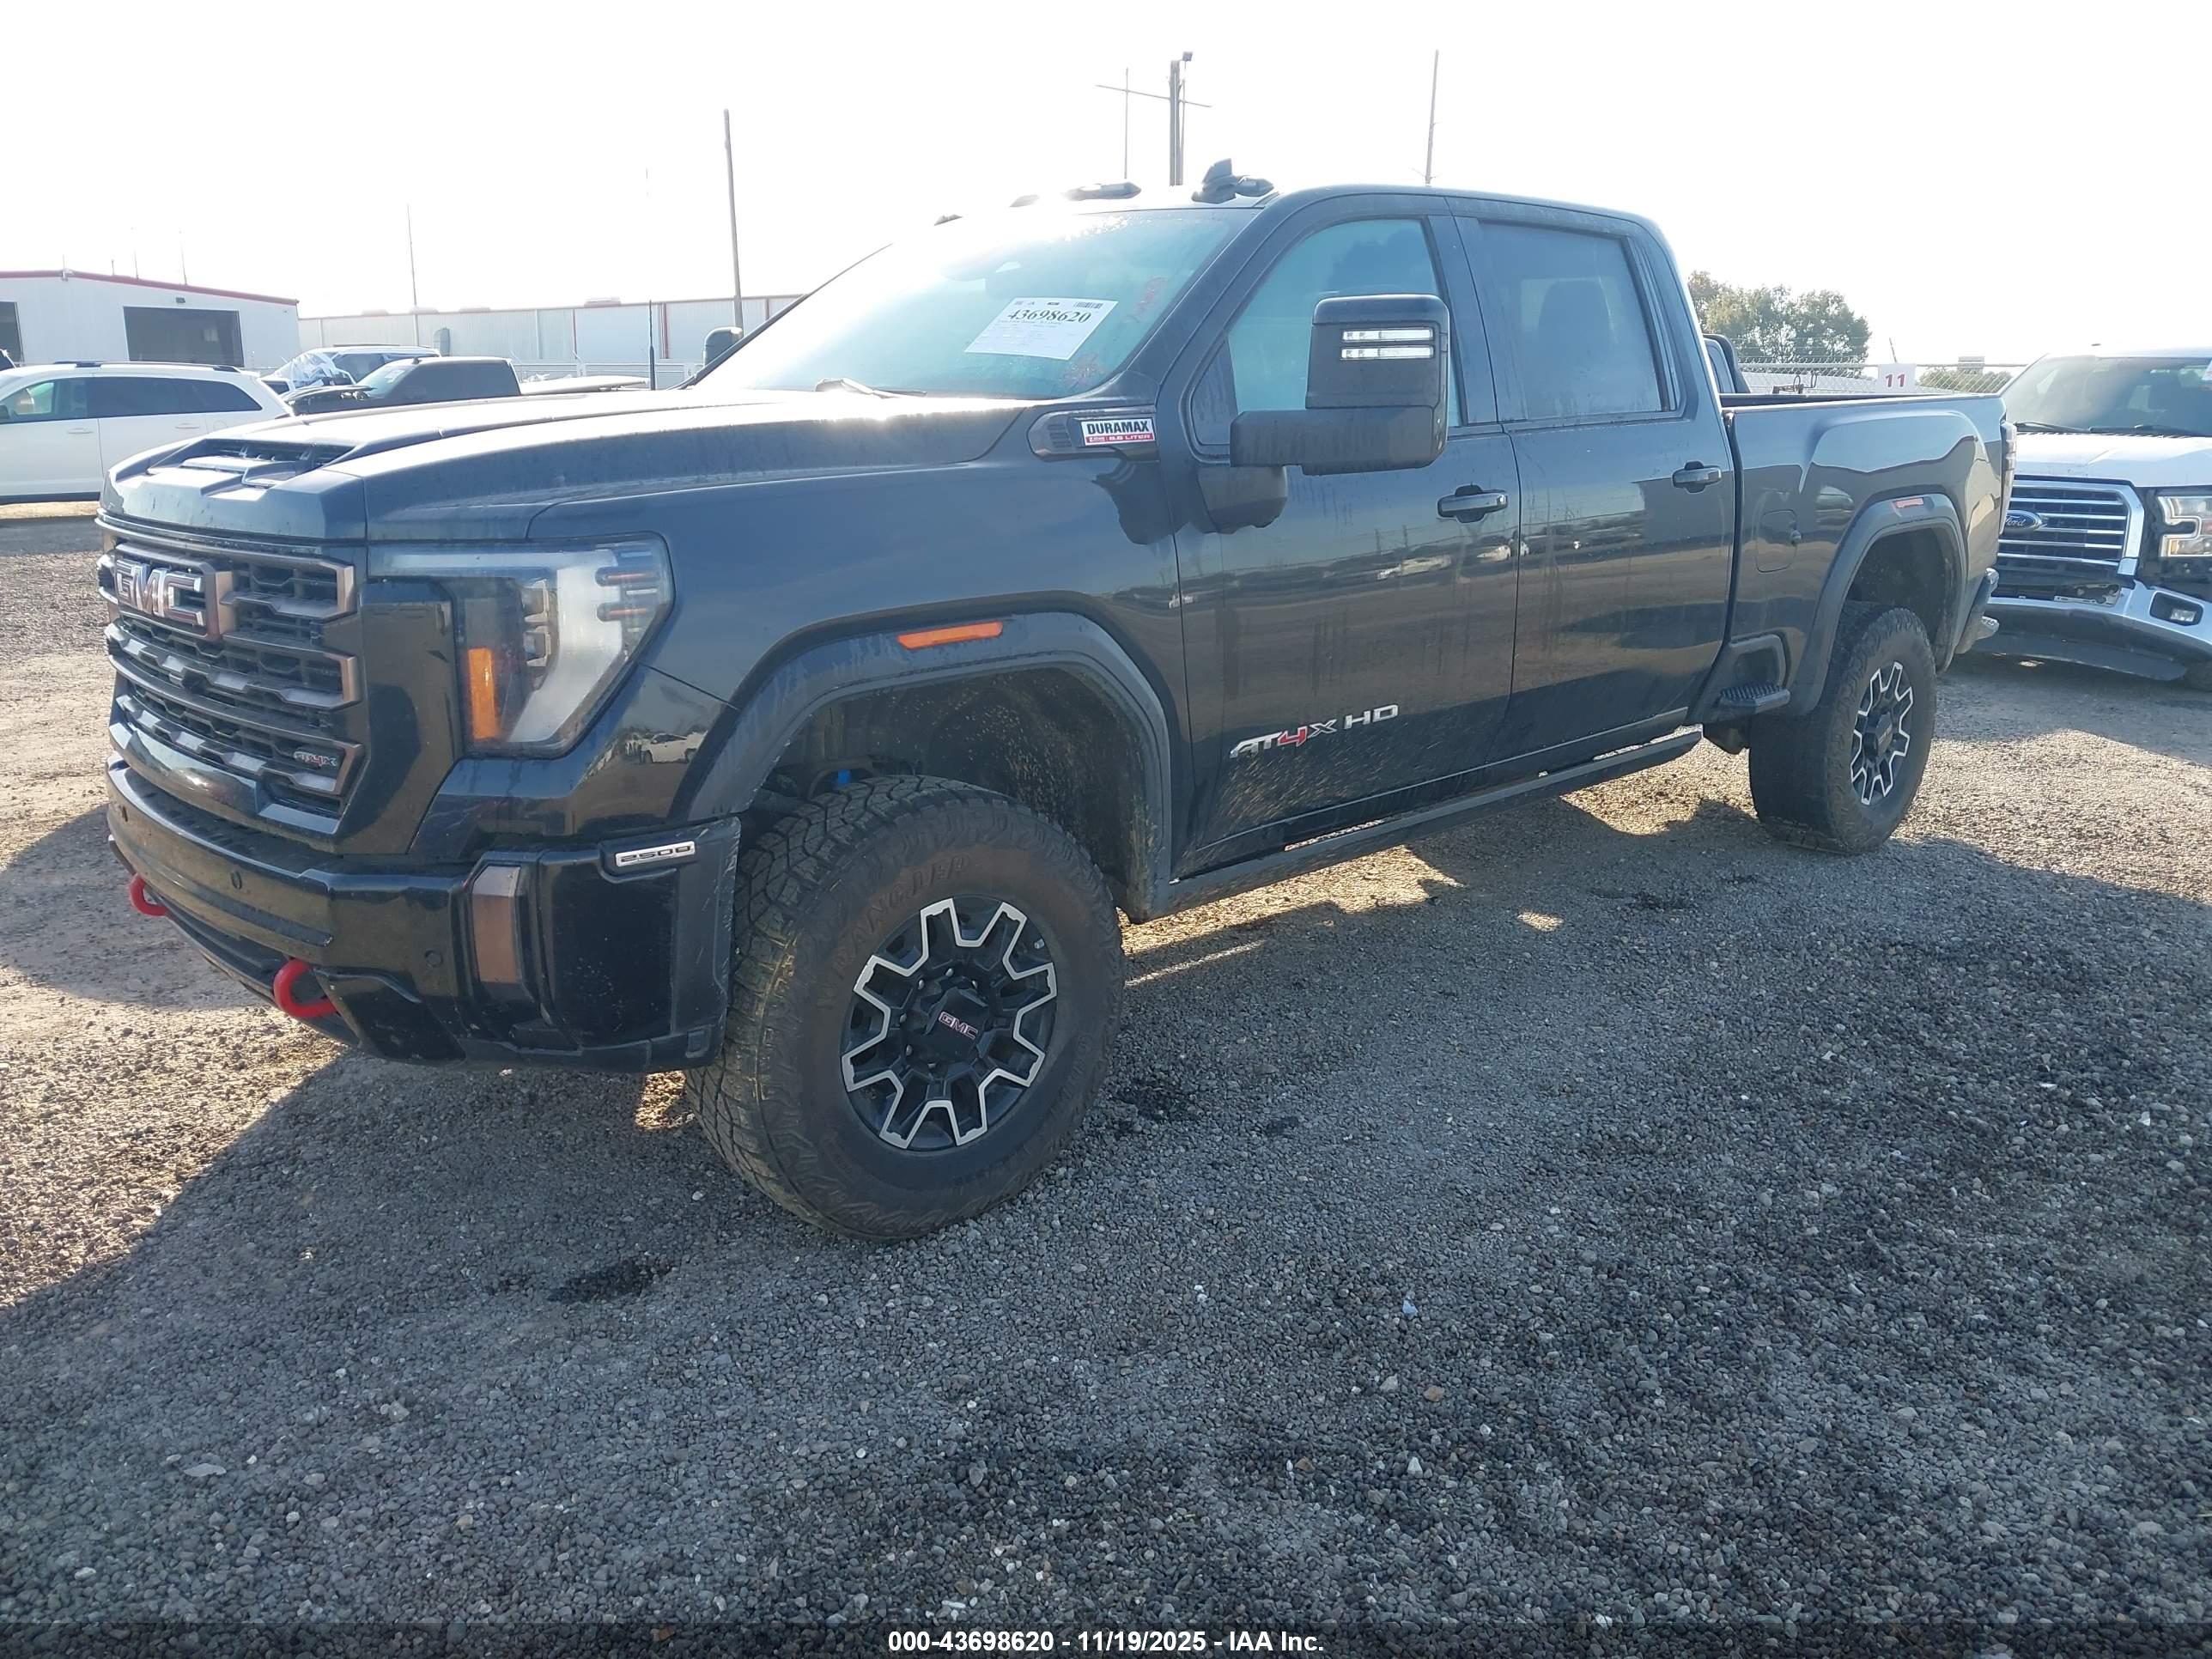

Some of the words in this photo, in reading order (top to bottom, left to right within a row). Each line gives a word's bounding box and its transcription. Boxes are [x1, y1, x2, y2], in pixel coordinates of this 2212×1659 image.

[1008, 309, 1091, 323] 43698620
[1885, 374, 1905, 387] 11
[1086, 421, 1150, 434] DURAMAX
[115, 559, 204, 627] GMC
[1230, 719, 1337, 758] AT4X
[1344, 704, 1399, 730] HD
[619, 844, 692, 864] 2500
[939, 1011, 978, 1040] GMC
